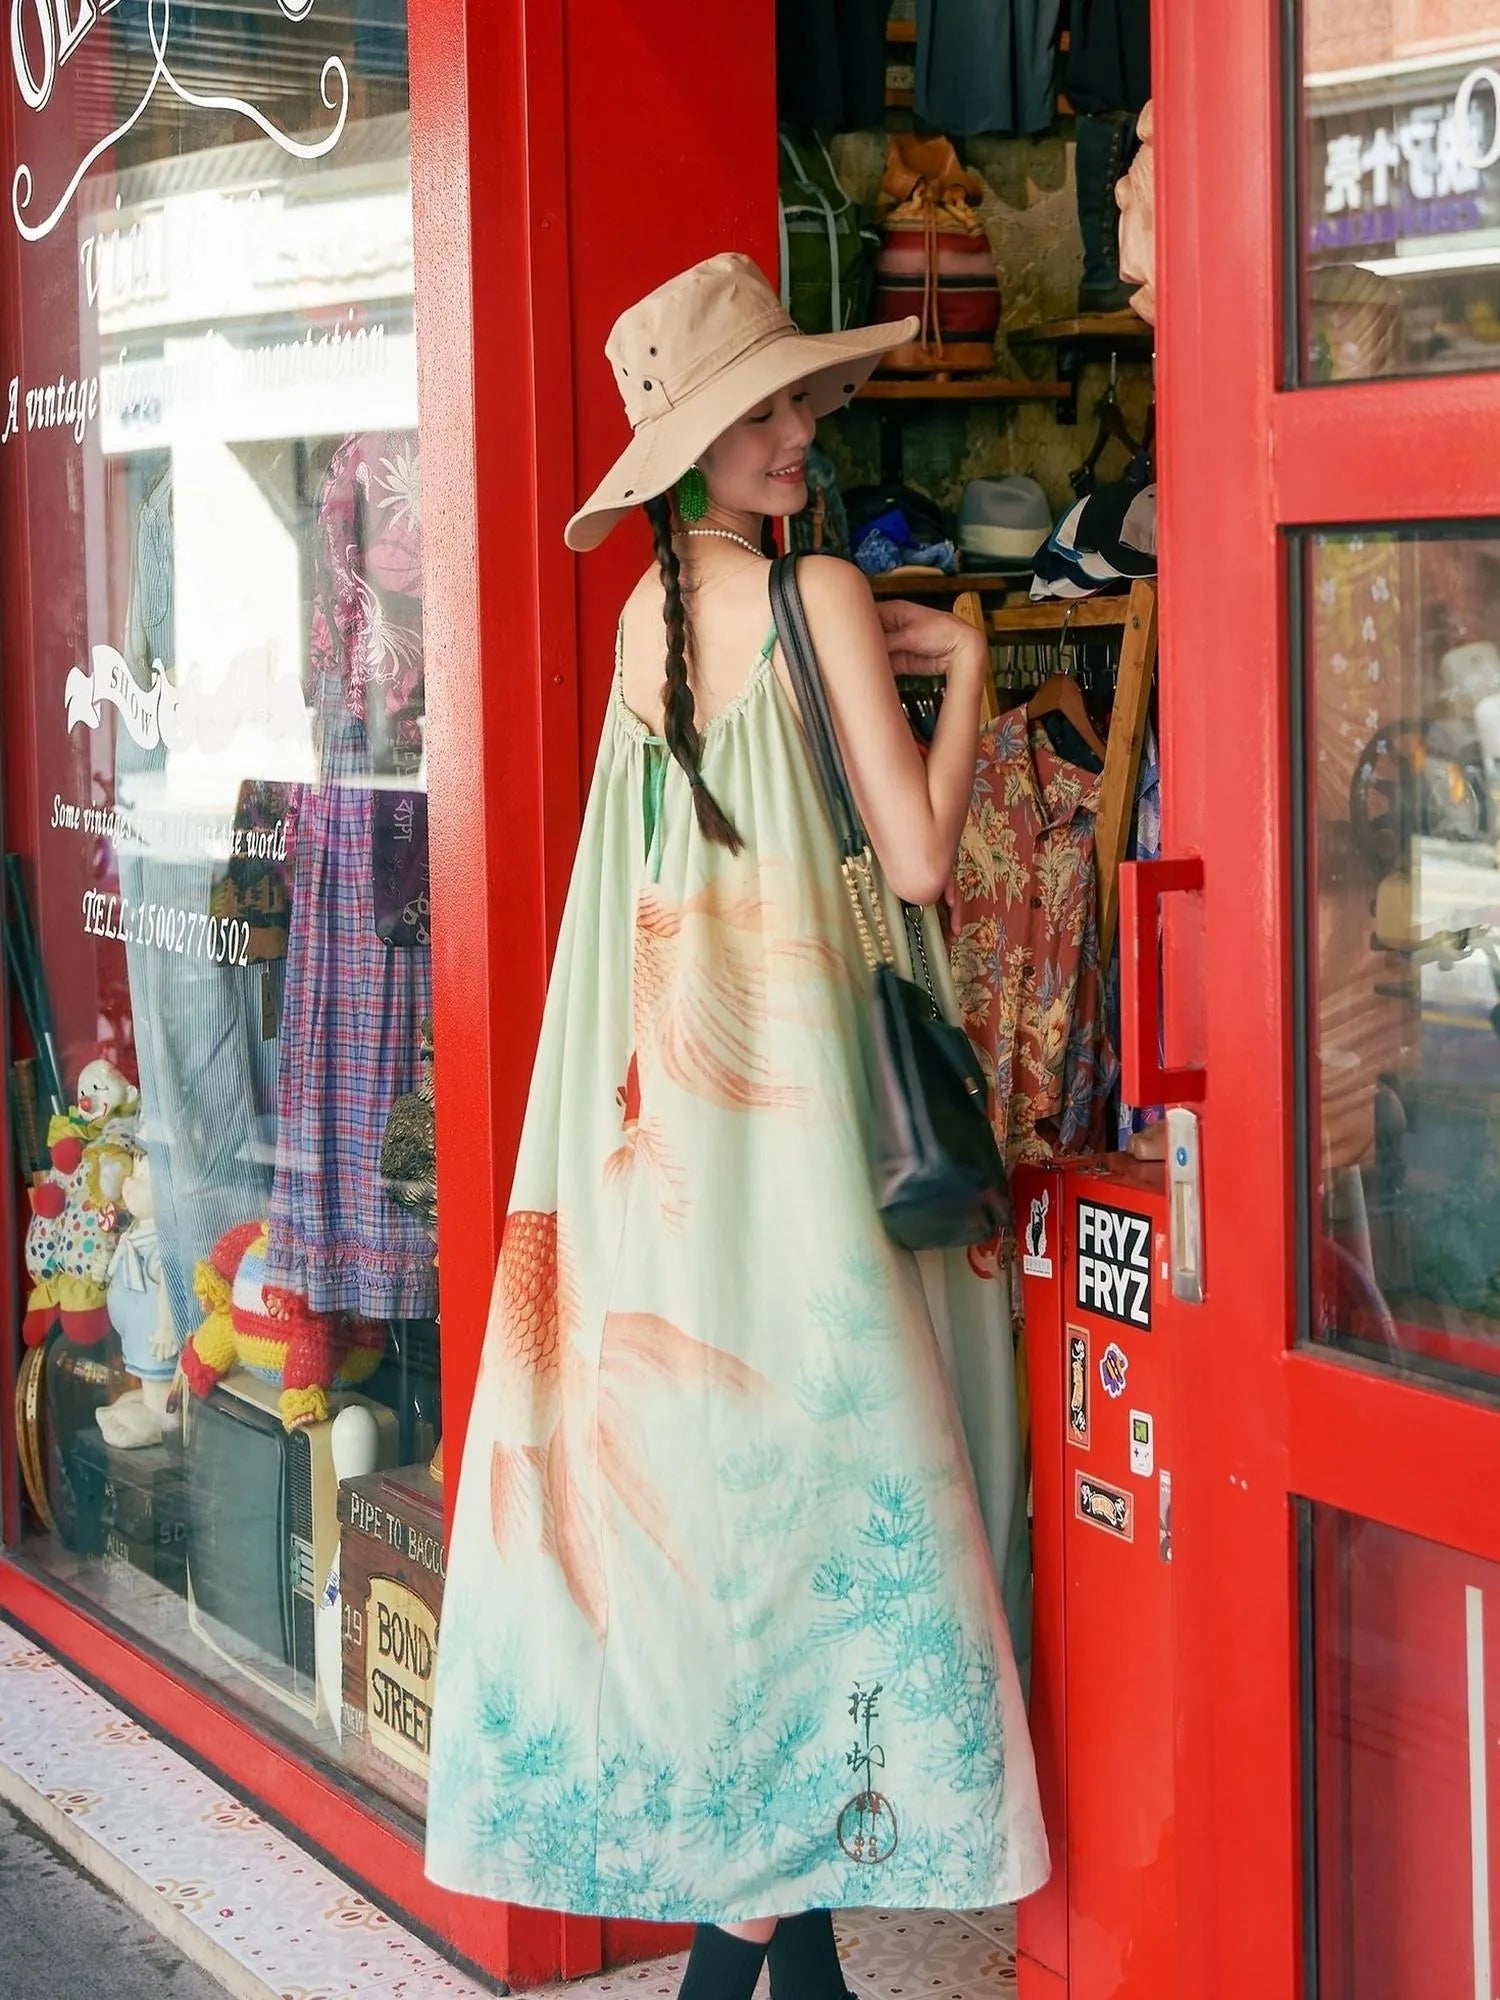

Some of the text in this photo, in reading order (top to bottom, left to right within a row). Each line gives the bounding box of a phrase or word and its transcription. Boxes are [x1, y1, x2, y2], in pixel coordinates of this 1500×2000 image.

[110, 665, 153, 736] SHOW
[51, 794, 81, 830] Some
[83, 800, 132, 849] vintages
[246, 819, 291, 862] world
[1078, 1203, 1151, 1269] FRYZ
[1078, 1255, 1150, 1326] FRYZ
[350, 1491, 383, 1540] PIPE
[386, 1512, 403, 1551] TO
[377, 1600, 433, 1681] BOND
[371, 1667, 433, 1756] STREET
